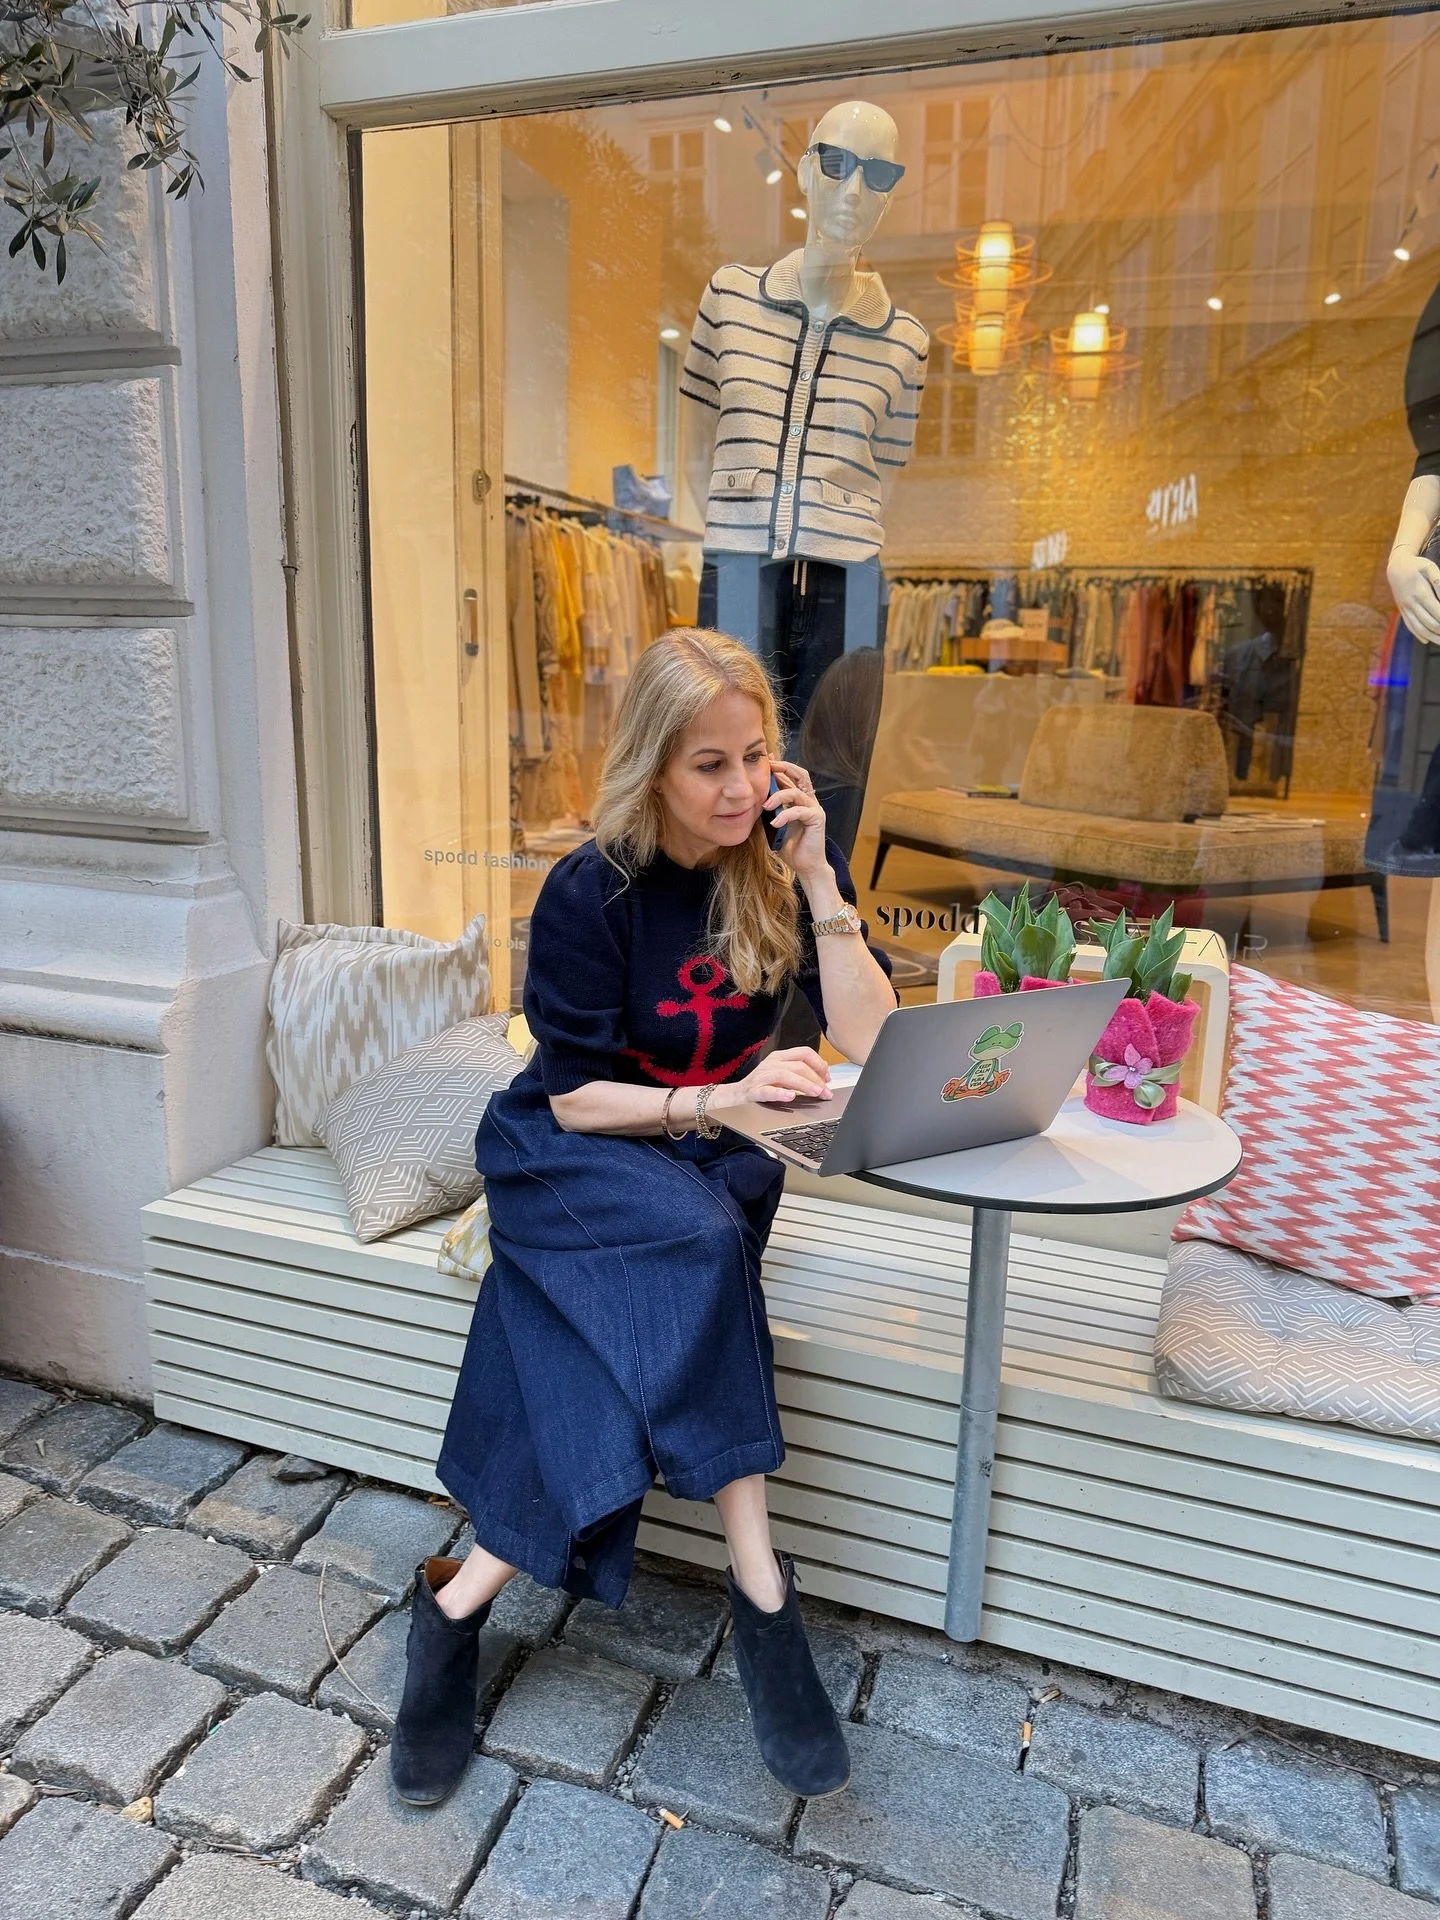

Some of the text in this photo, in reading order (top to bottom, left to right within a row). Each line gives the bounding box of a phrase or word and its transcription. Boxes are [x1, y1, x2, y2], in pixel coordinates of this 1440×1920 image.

[424, 849, 548, 870] spodd fashion
[876, 902, 981, 937] spodd
[507, 936, 527, 951] bis
